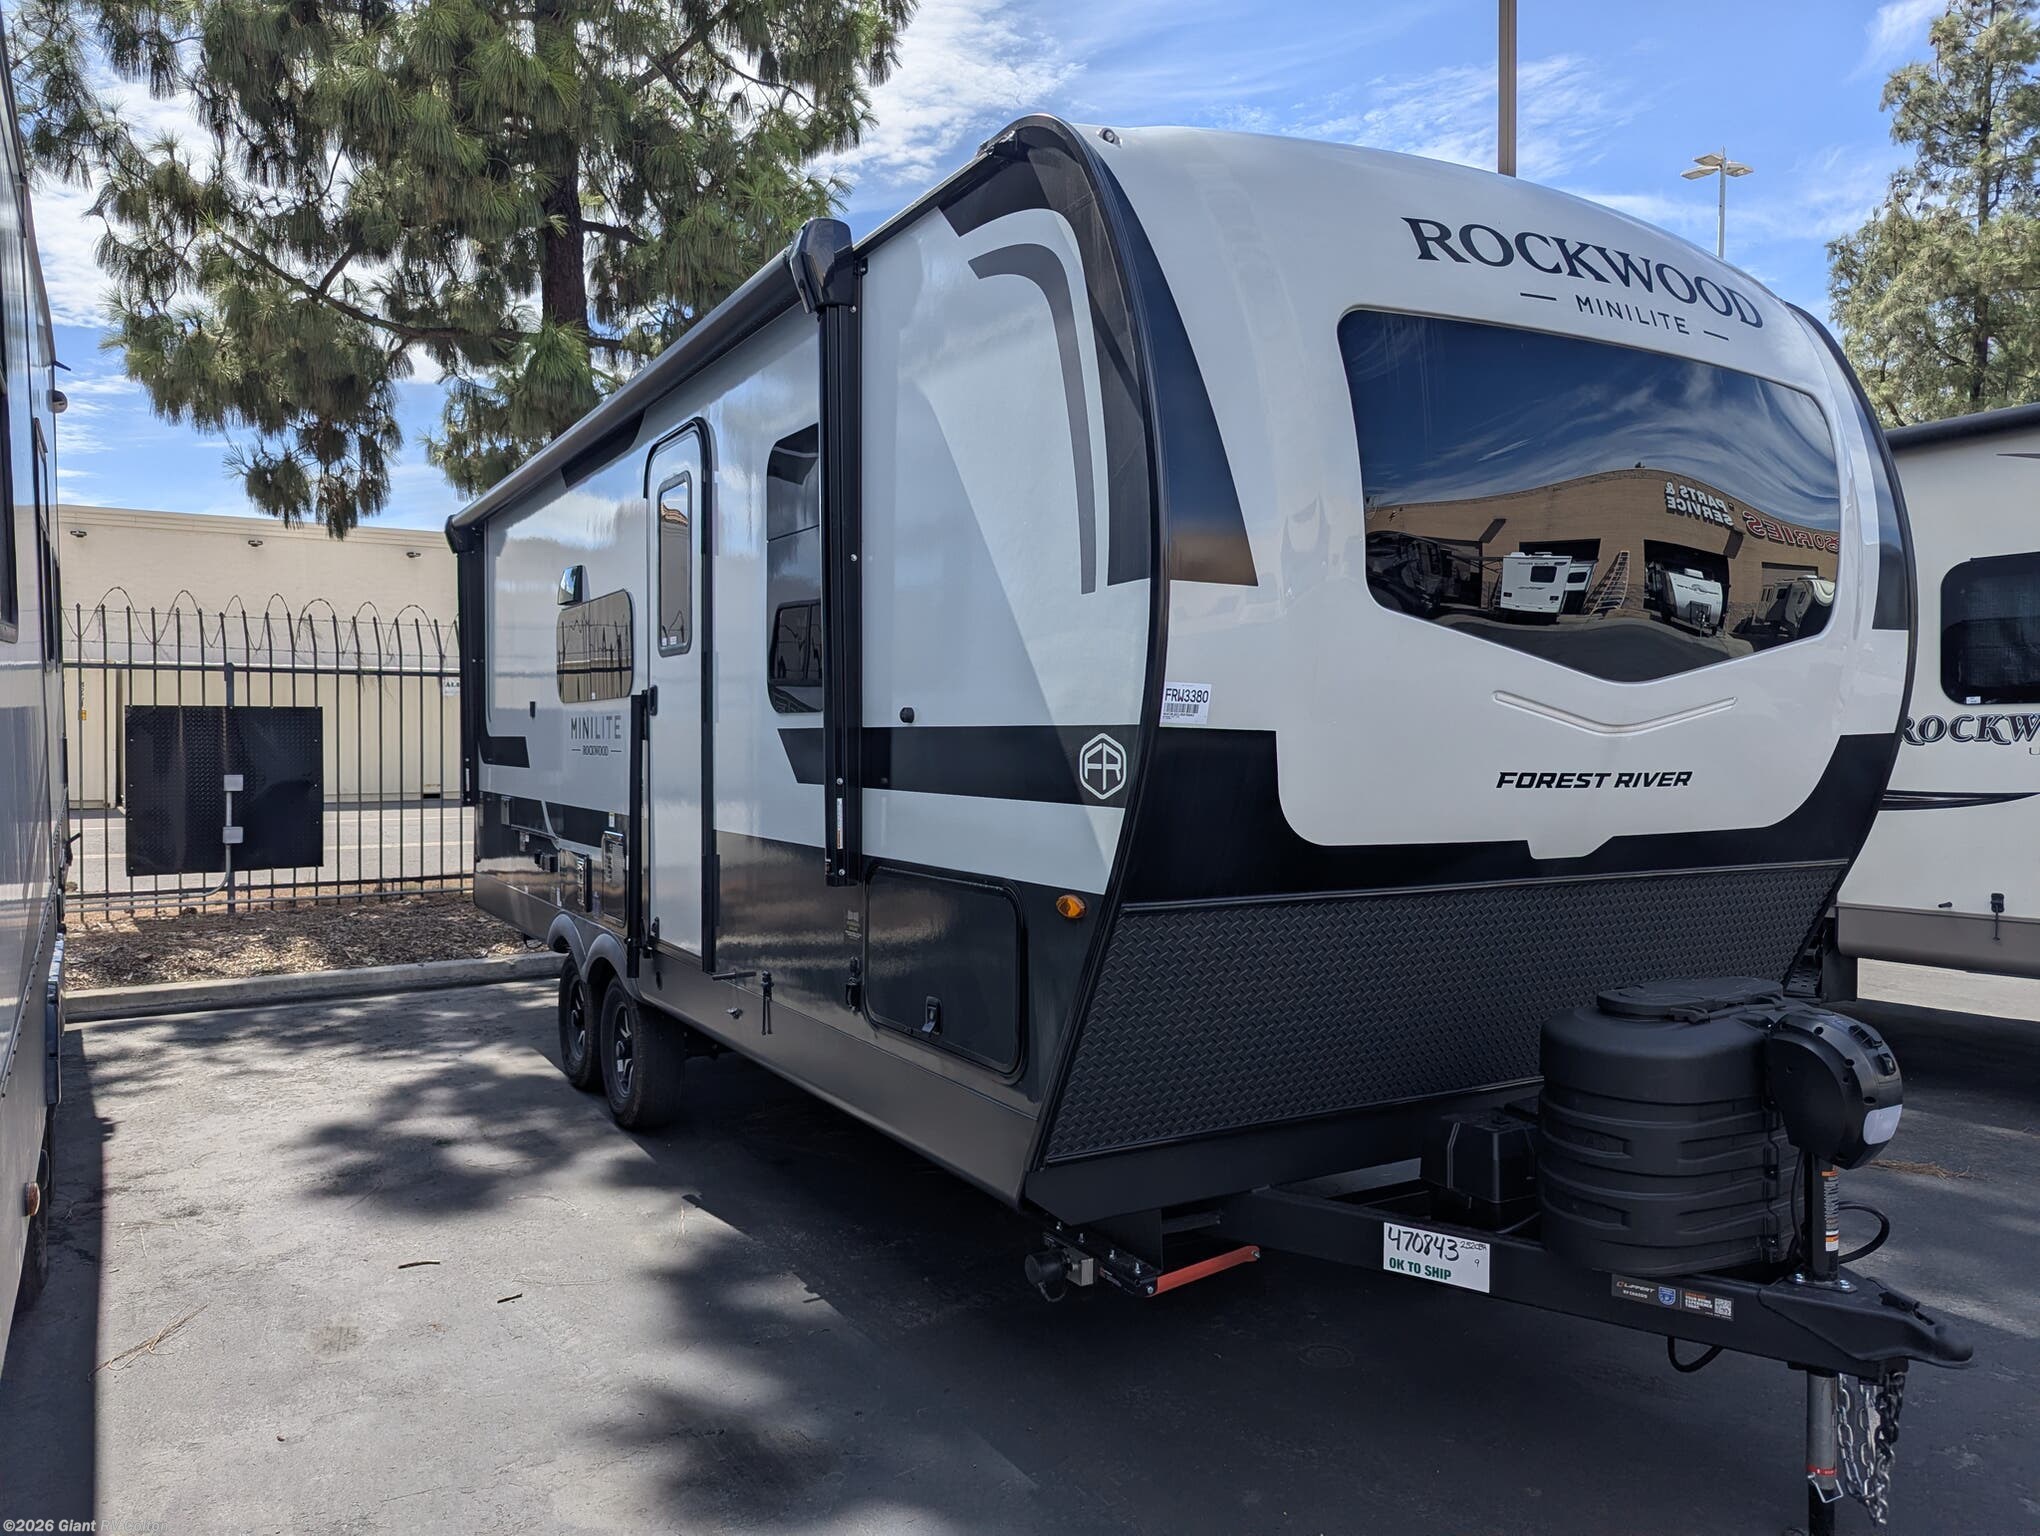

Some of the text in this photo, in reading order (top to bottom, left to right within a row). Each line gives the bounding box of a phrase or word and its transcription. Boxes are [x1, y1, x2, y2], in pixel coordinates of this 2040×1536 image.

[1401, 217, 1763, 329] ROCKWOOD
[1576, 294, 1690, 336] MINILITE
[1165, 688, 1209, 703] FRW3380
[571, 716, 622, 739] MINILITE
[1496, 771, 1693, 789] FOREST RIVER
[1388, 1226, 1460, 1262] 470843
[1389, 1257, 1451, 1281] OK TO SHIP
